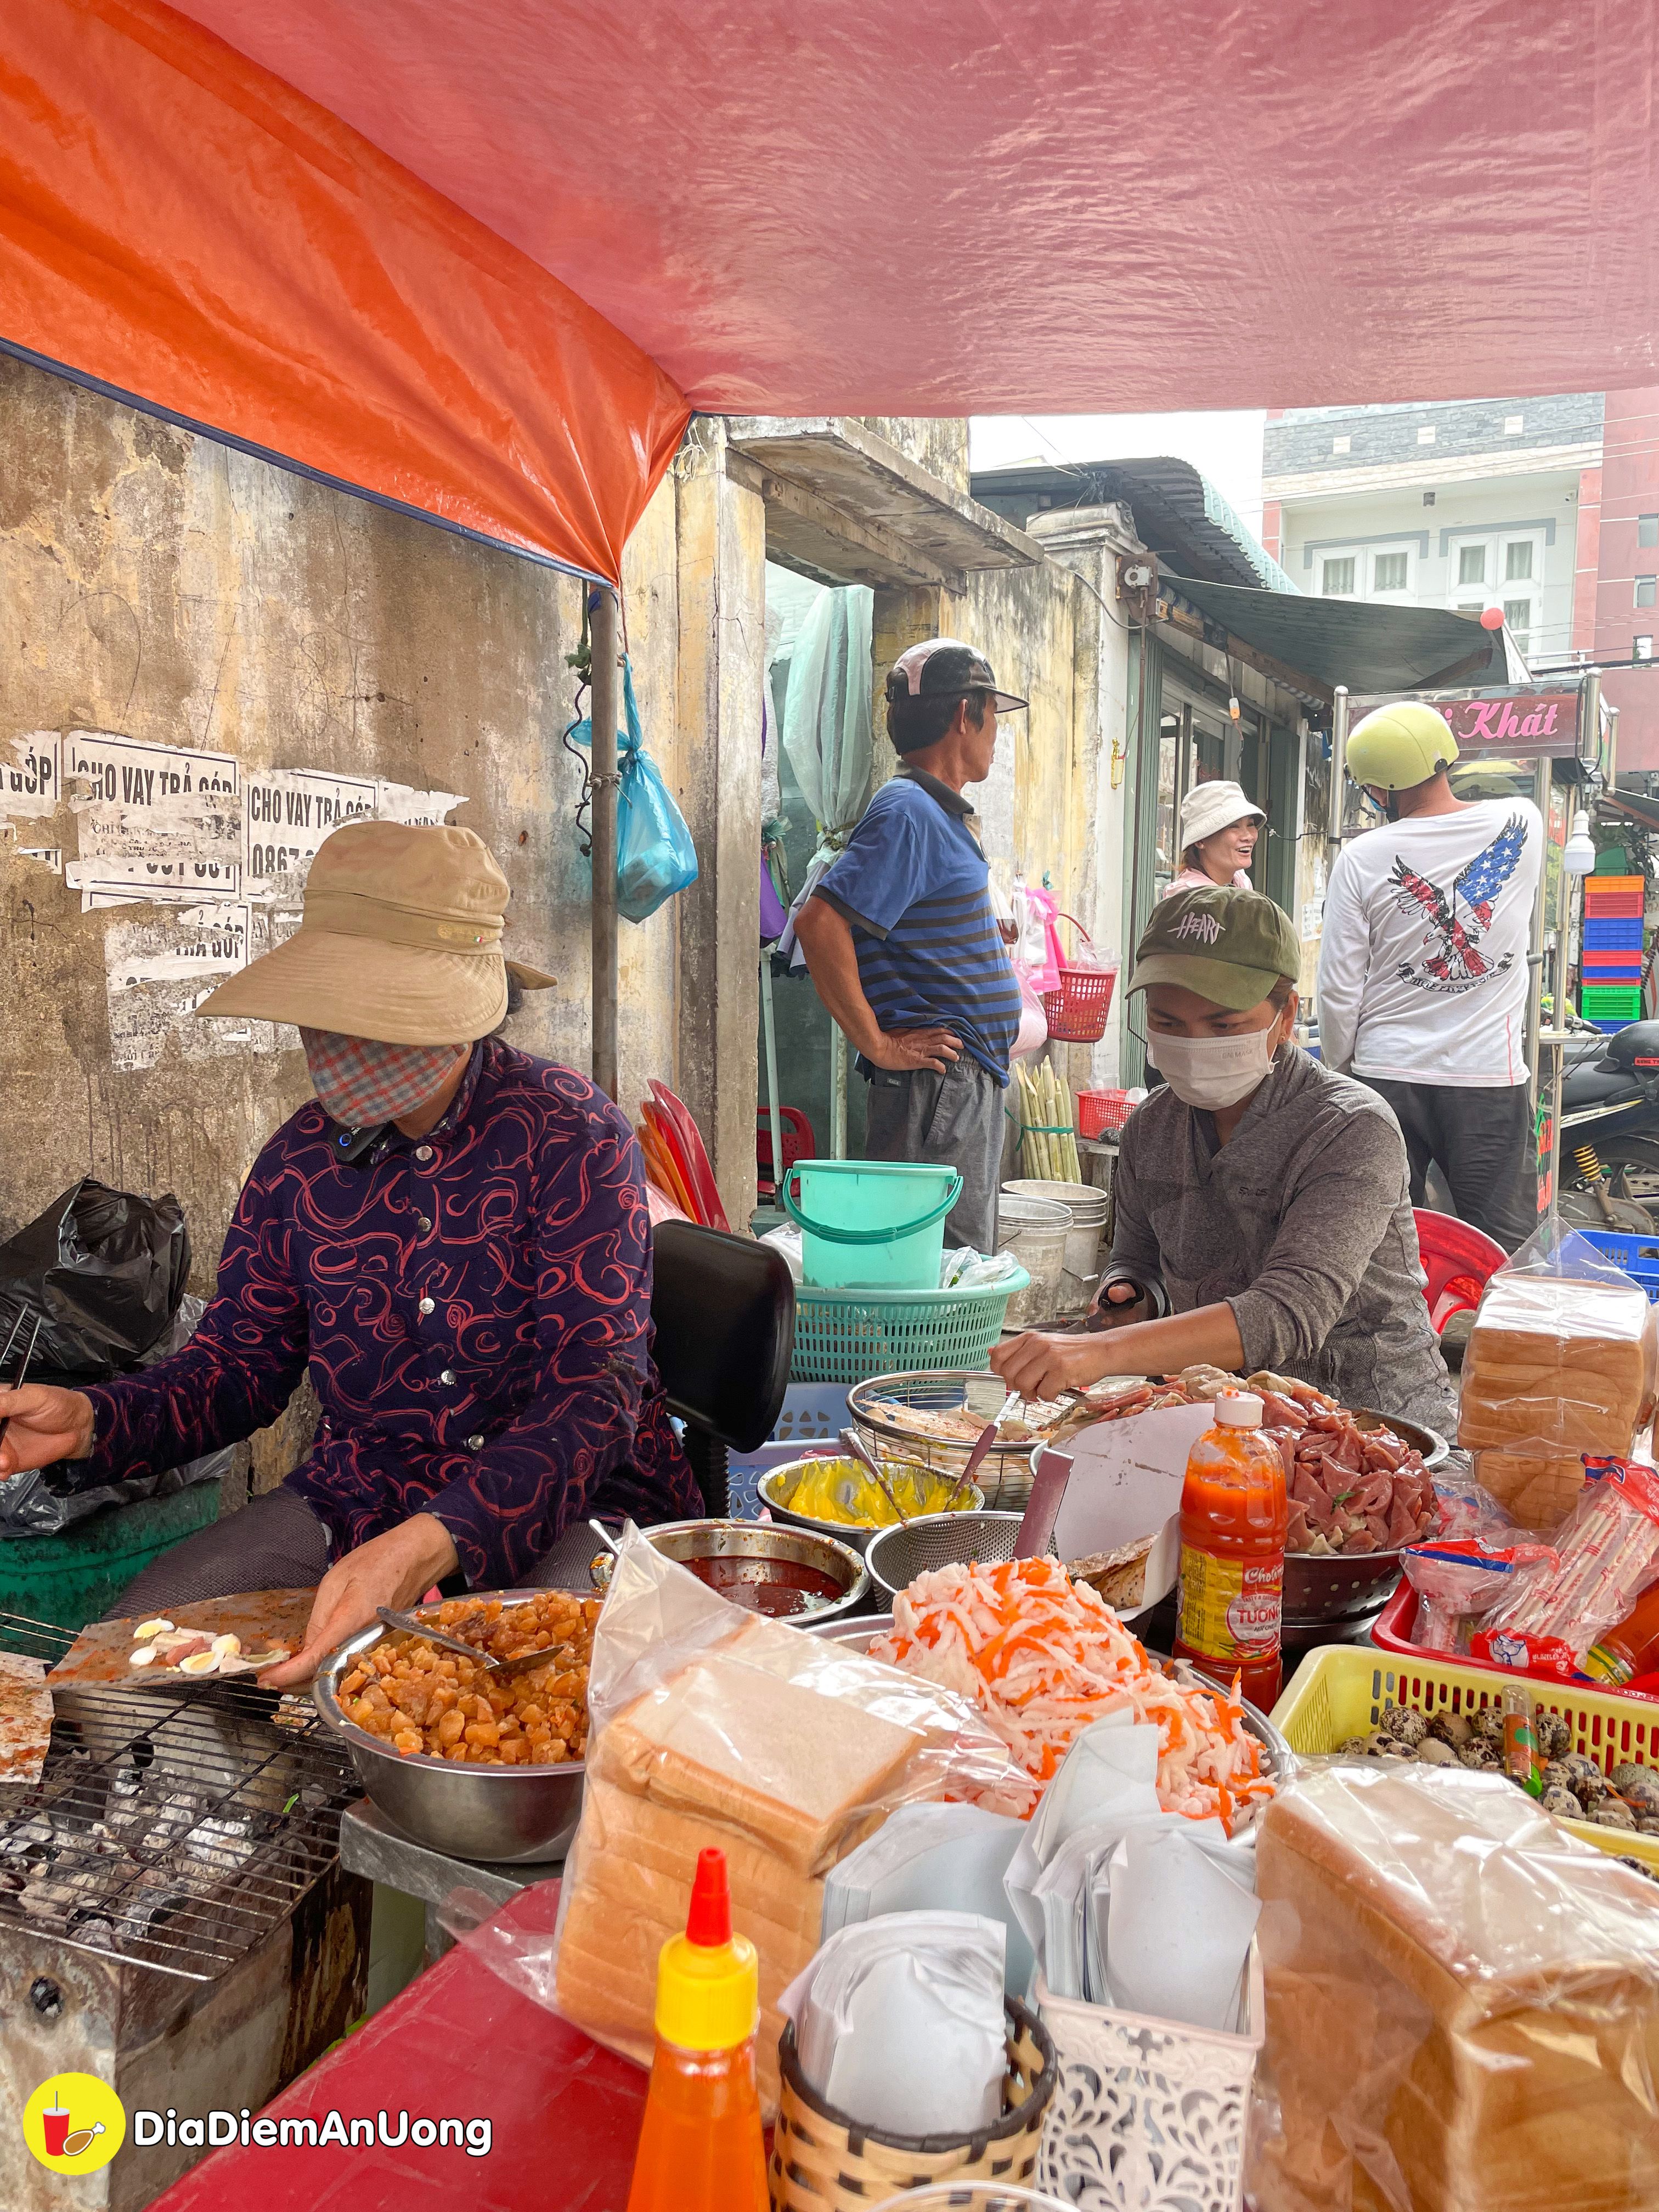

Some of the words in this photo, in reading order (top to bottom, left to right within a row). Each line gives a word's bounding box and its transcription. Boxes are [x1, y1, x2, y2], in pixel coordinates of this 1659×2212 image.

[1458, 701, 1559, 739] Khát
[122, 766, 155, 806] VAY
[251, 786, 281, 824] CHO
[286, 791, 312, 828] VAY
